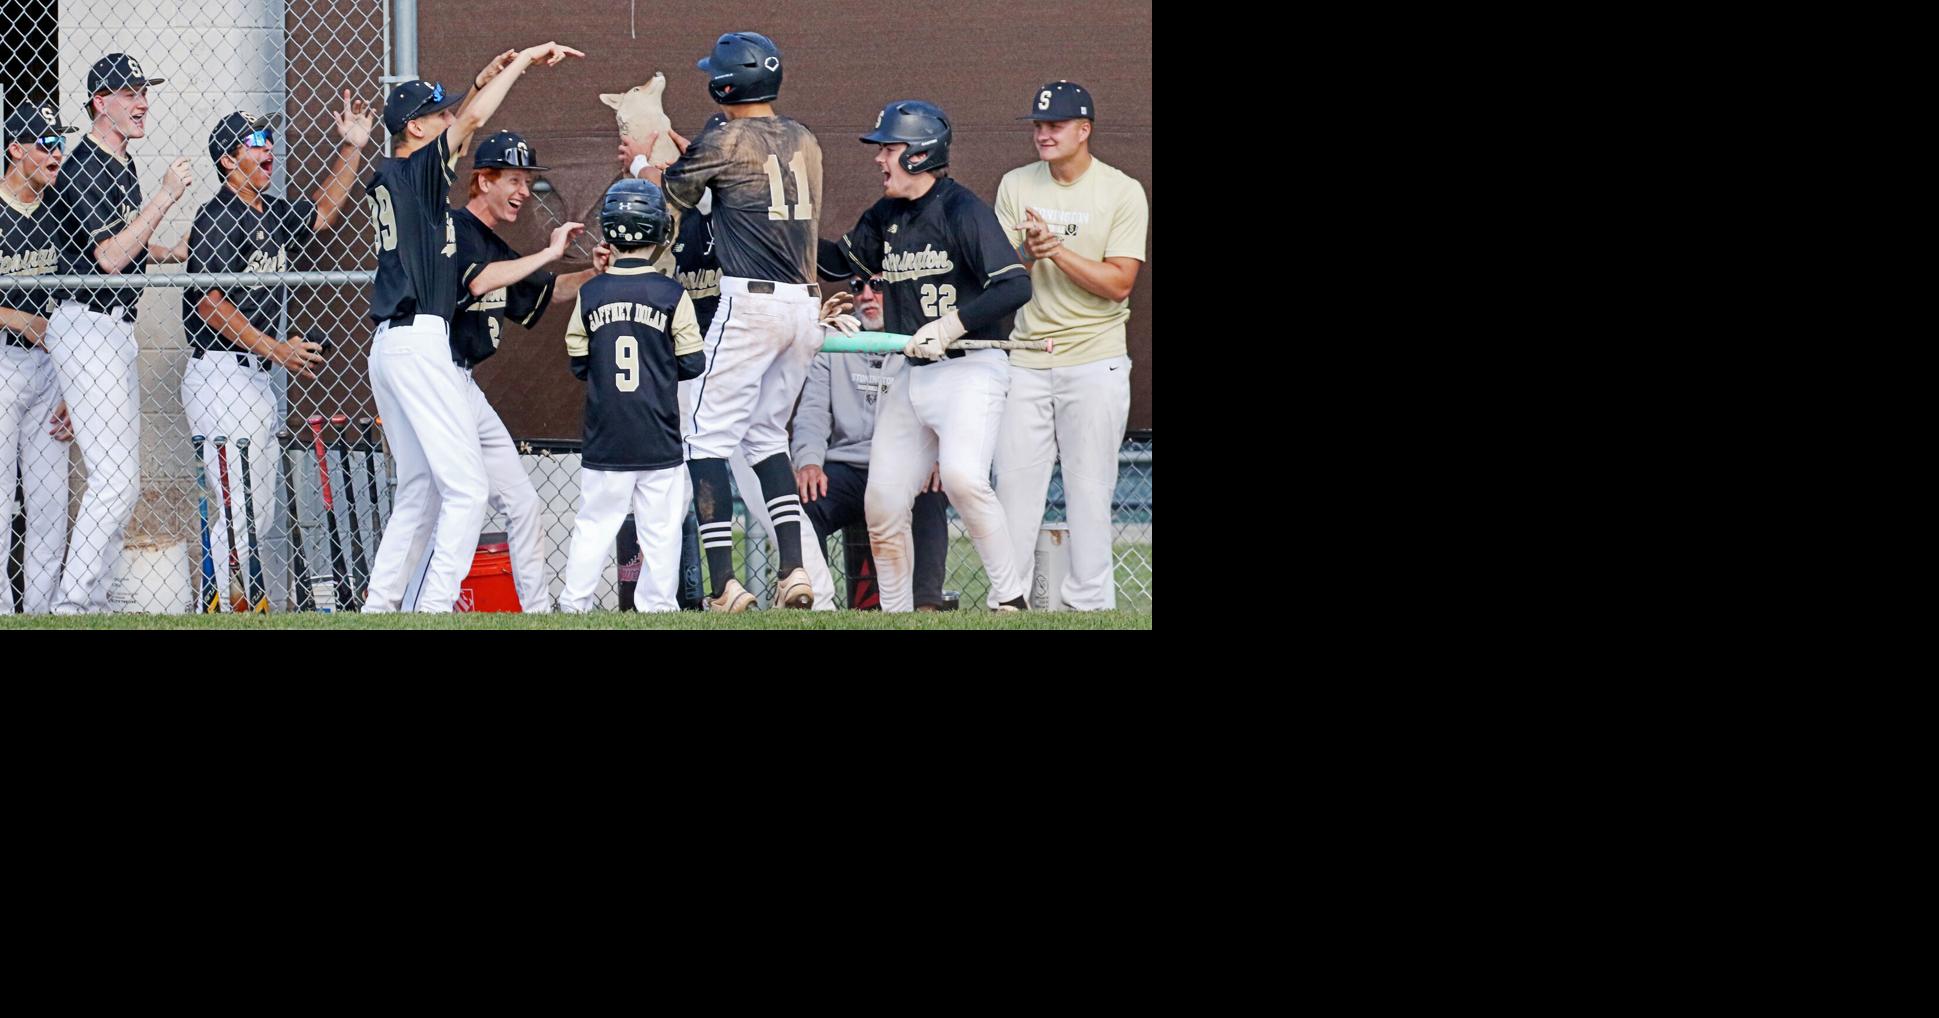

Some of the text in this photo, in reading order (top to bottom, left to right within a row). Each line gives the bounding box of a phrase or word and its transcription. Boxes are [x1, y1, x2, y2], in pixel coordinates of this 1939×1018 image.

[128, 59, 141, 78] S
[1038, 90, 1052, 110] S
[42, 106, 57, 126] S
[763, 151, 812, 220] 11
[920, 283, 957, 317] 22
[634, 303, 668, 333] DOLAN
[615, 335, 640, 392] 9
